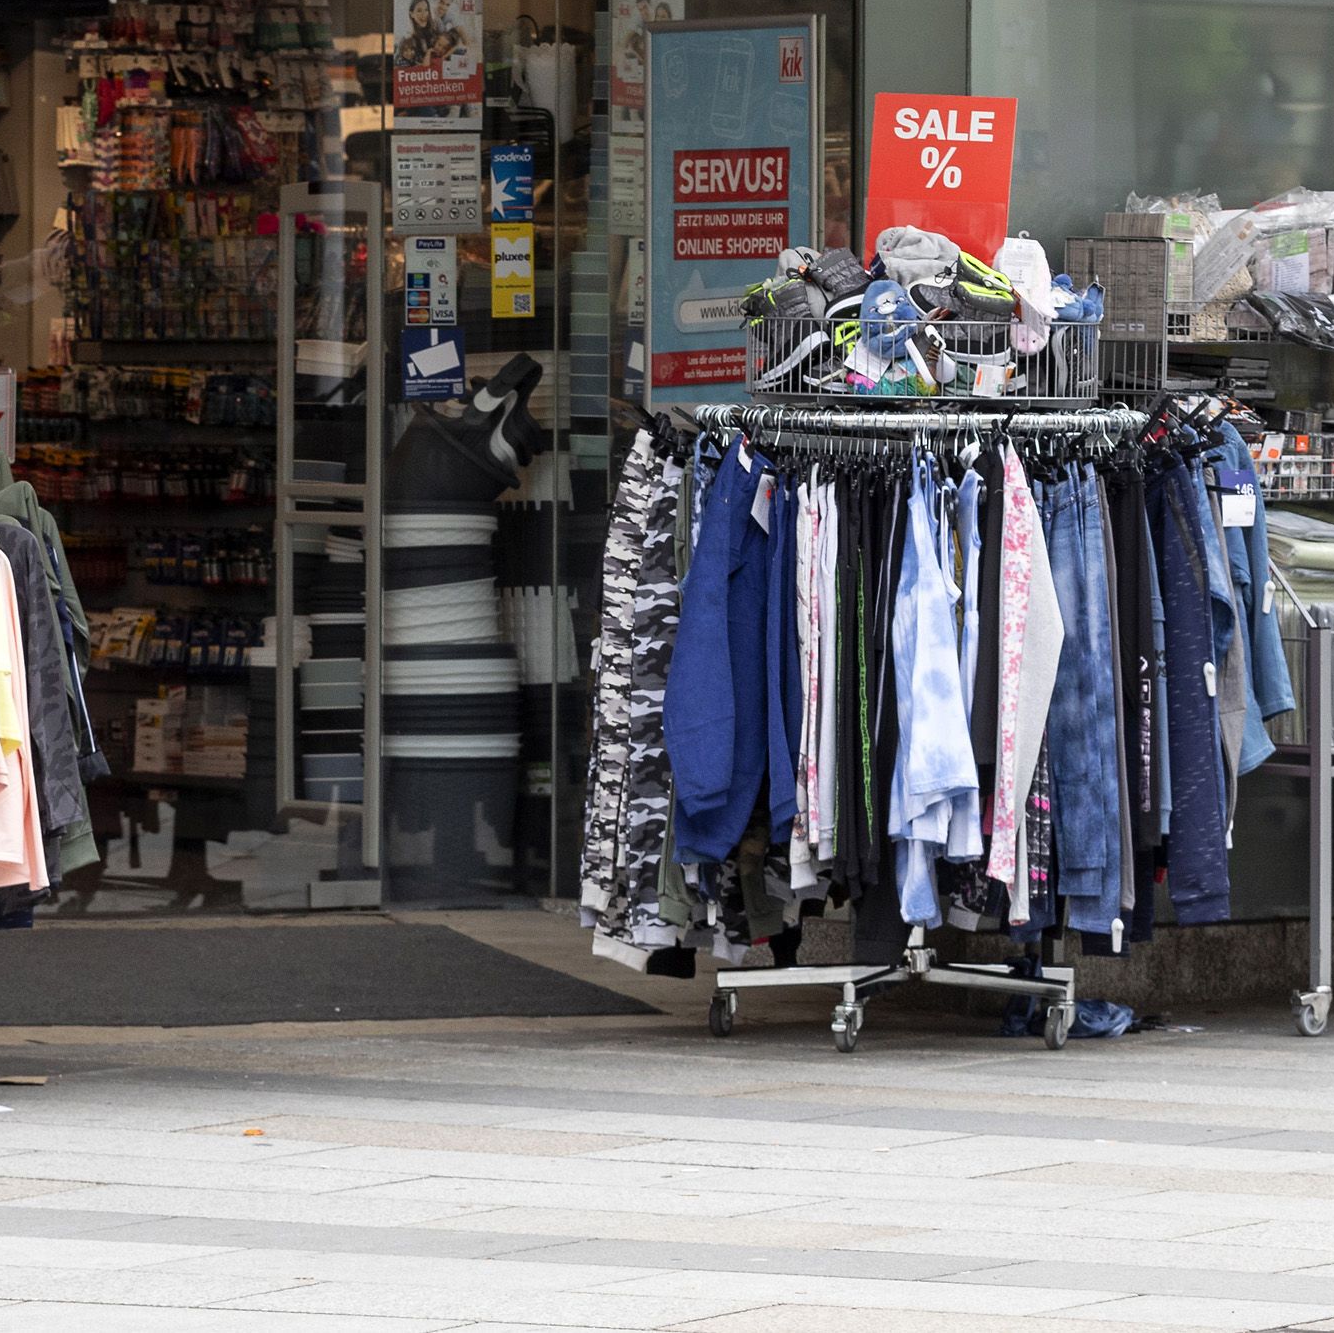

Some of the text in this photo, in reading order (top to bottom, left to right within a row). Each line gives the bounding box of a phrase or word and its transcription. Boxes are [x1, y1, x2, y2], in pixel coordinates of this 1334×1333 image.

[780, 42, 803, 80] kik
[398, 69, 439, 82] Freude
[398, 81, 465, 96] verschenken
[893, 107, 996, 143] SALE
[493, 152, 532, 163] sodexo
[678, 157, 783, 194] SERVUS!
[920, 147, 962, 189] %
[677, 212, 784, 227] JETZT RUND UM DIE UHR
[418, 240, 444, 249] PayLife
[677, 237, 783, 255] ONLINE SHOPPEN
[494, 252, 531, 264] pluxee
[435, 309, 455, 319] VISA
